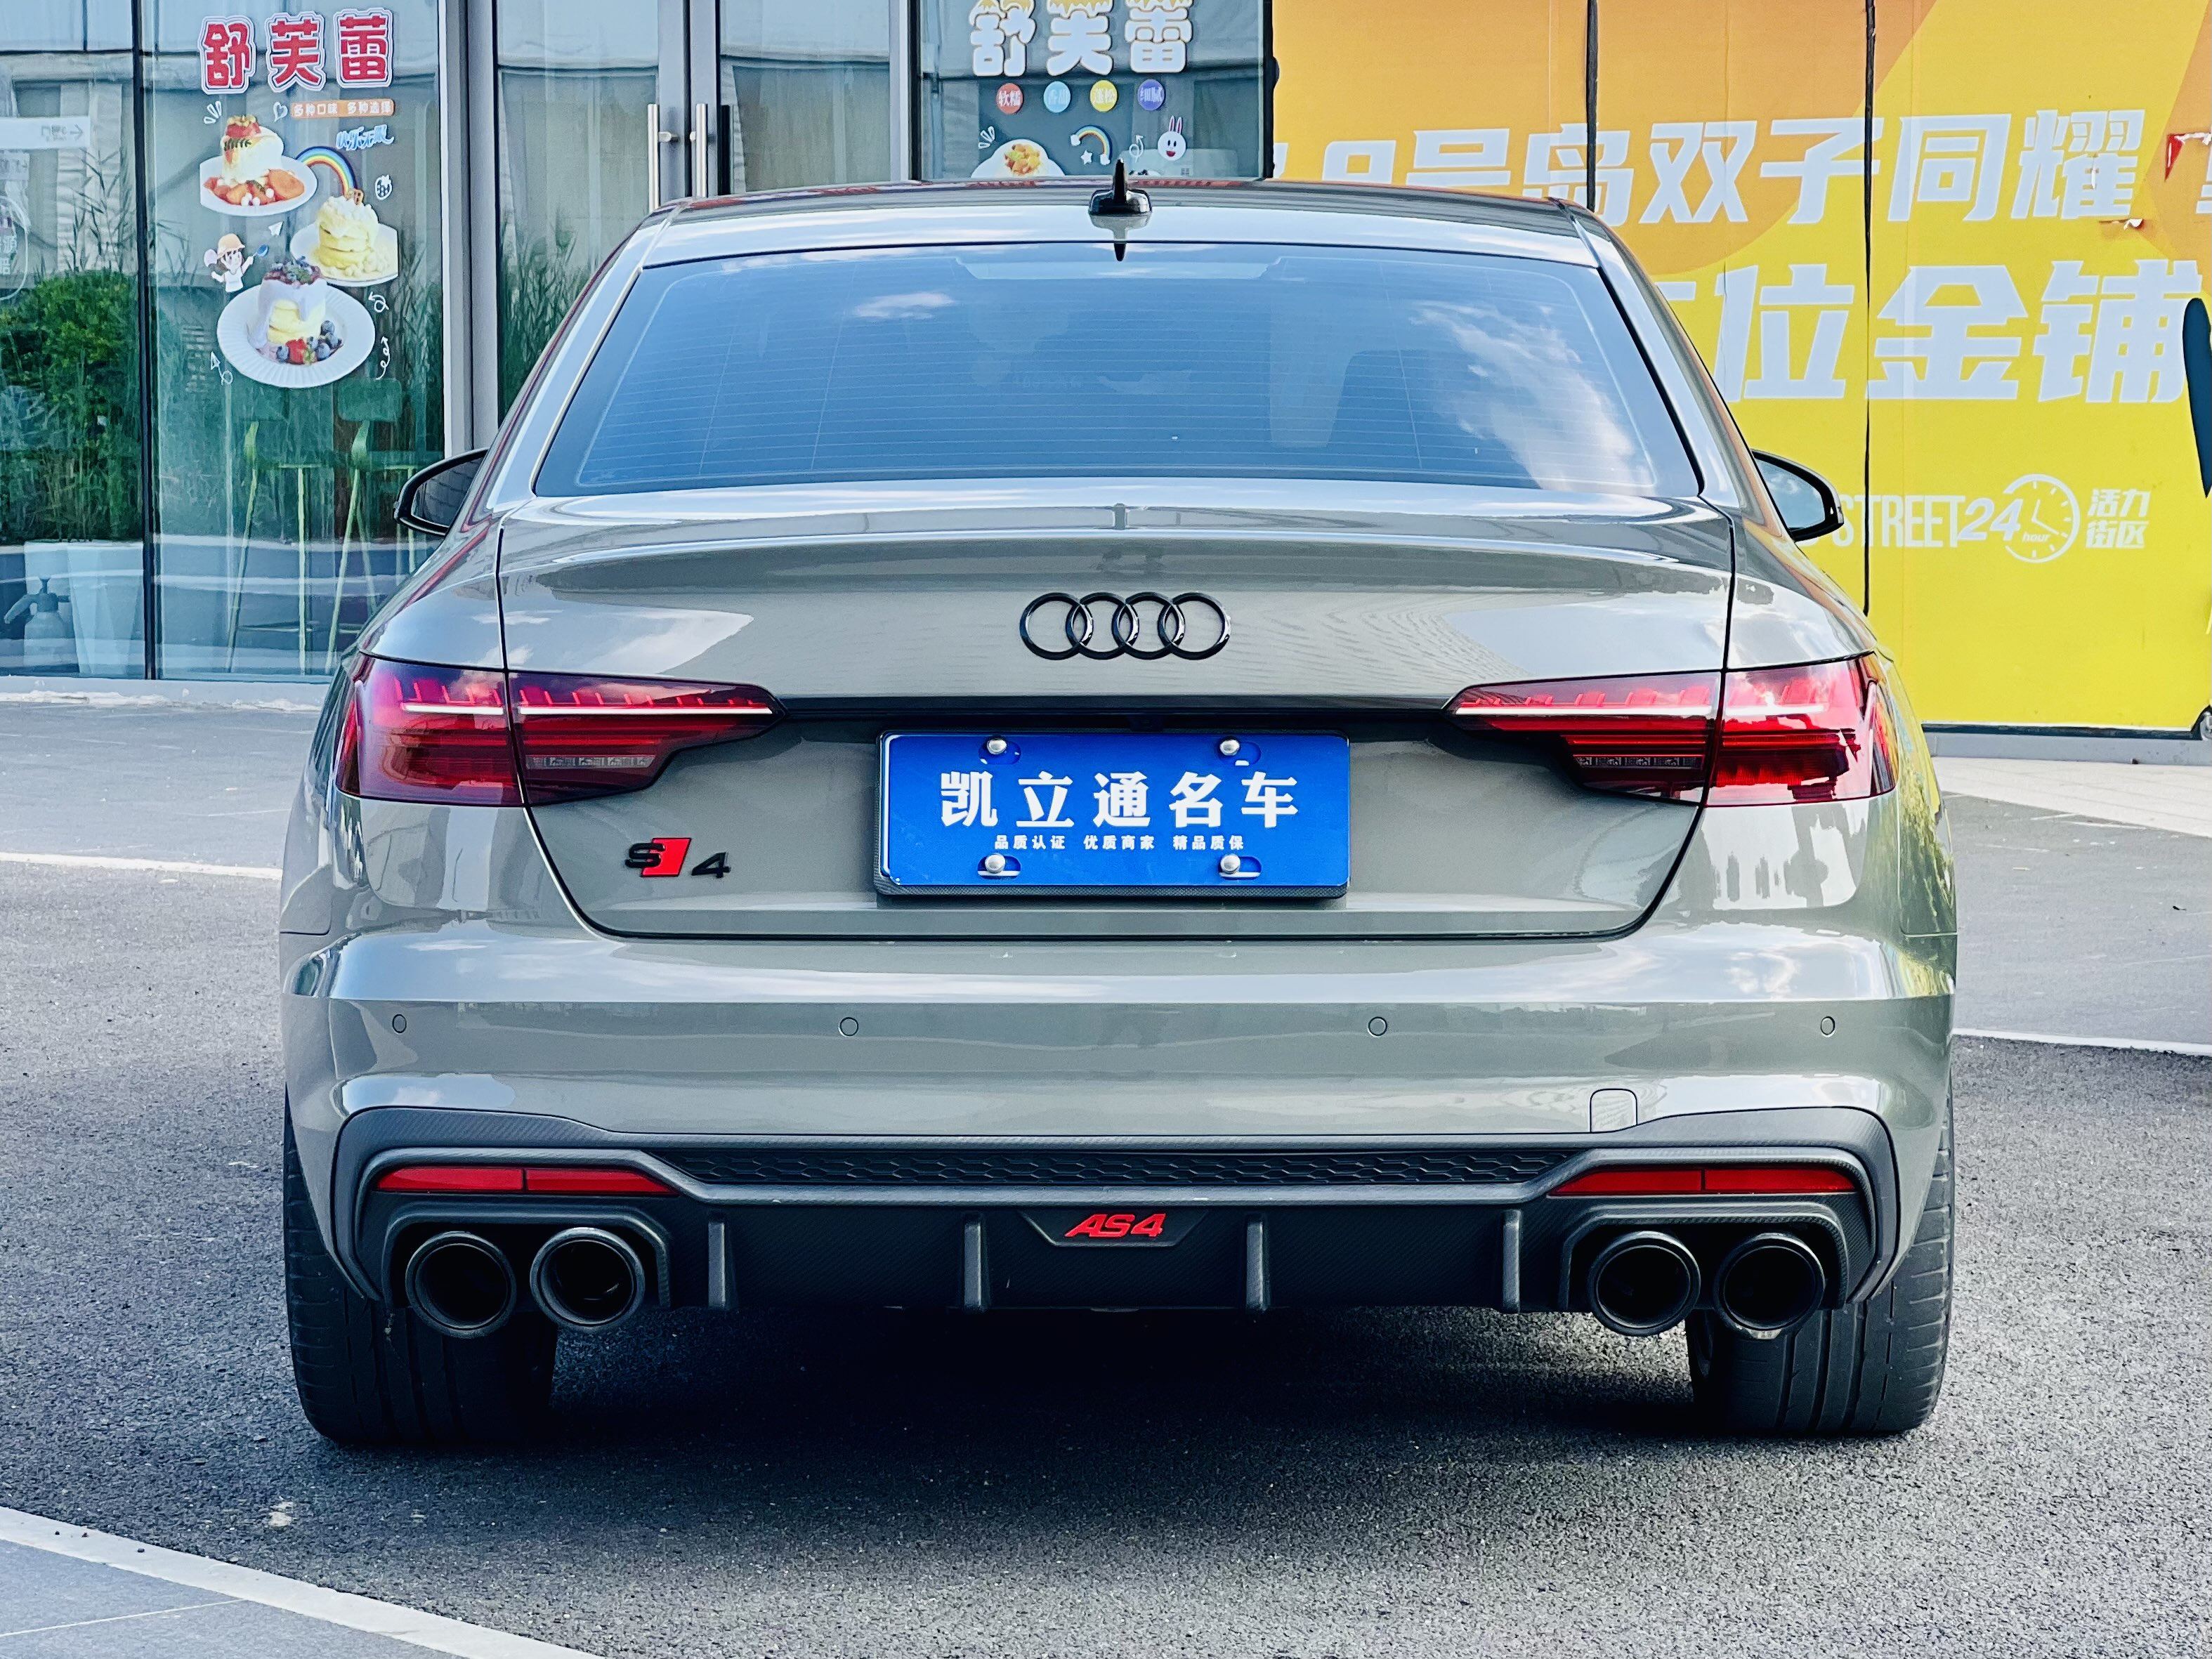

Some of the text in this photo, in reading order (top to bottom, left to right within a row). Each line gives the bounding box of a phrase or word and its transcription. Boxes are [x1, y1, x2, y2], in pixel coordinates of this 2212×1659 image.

[201, 10, 392, 91] 舒芙蕾
[969, 0, 1193, 77] 舒芙蕾
[294, 103, 338, 116] 多种口味
[1655, 260, 2204, 404] 位金铺
[2088, 488, 2152, 518] 活力
[2022, 531, 2050, 543] hour
[2085, 520, 2150, 549] 街区
[940, 771, 1299, 828] 凯立通名车
[994, 834, 1245, 850] 品质认证 优质商家 精品质保
[1064, 1212, 1167, 1238] AS4
